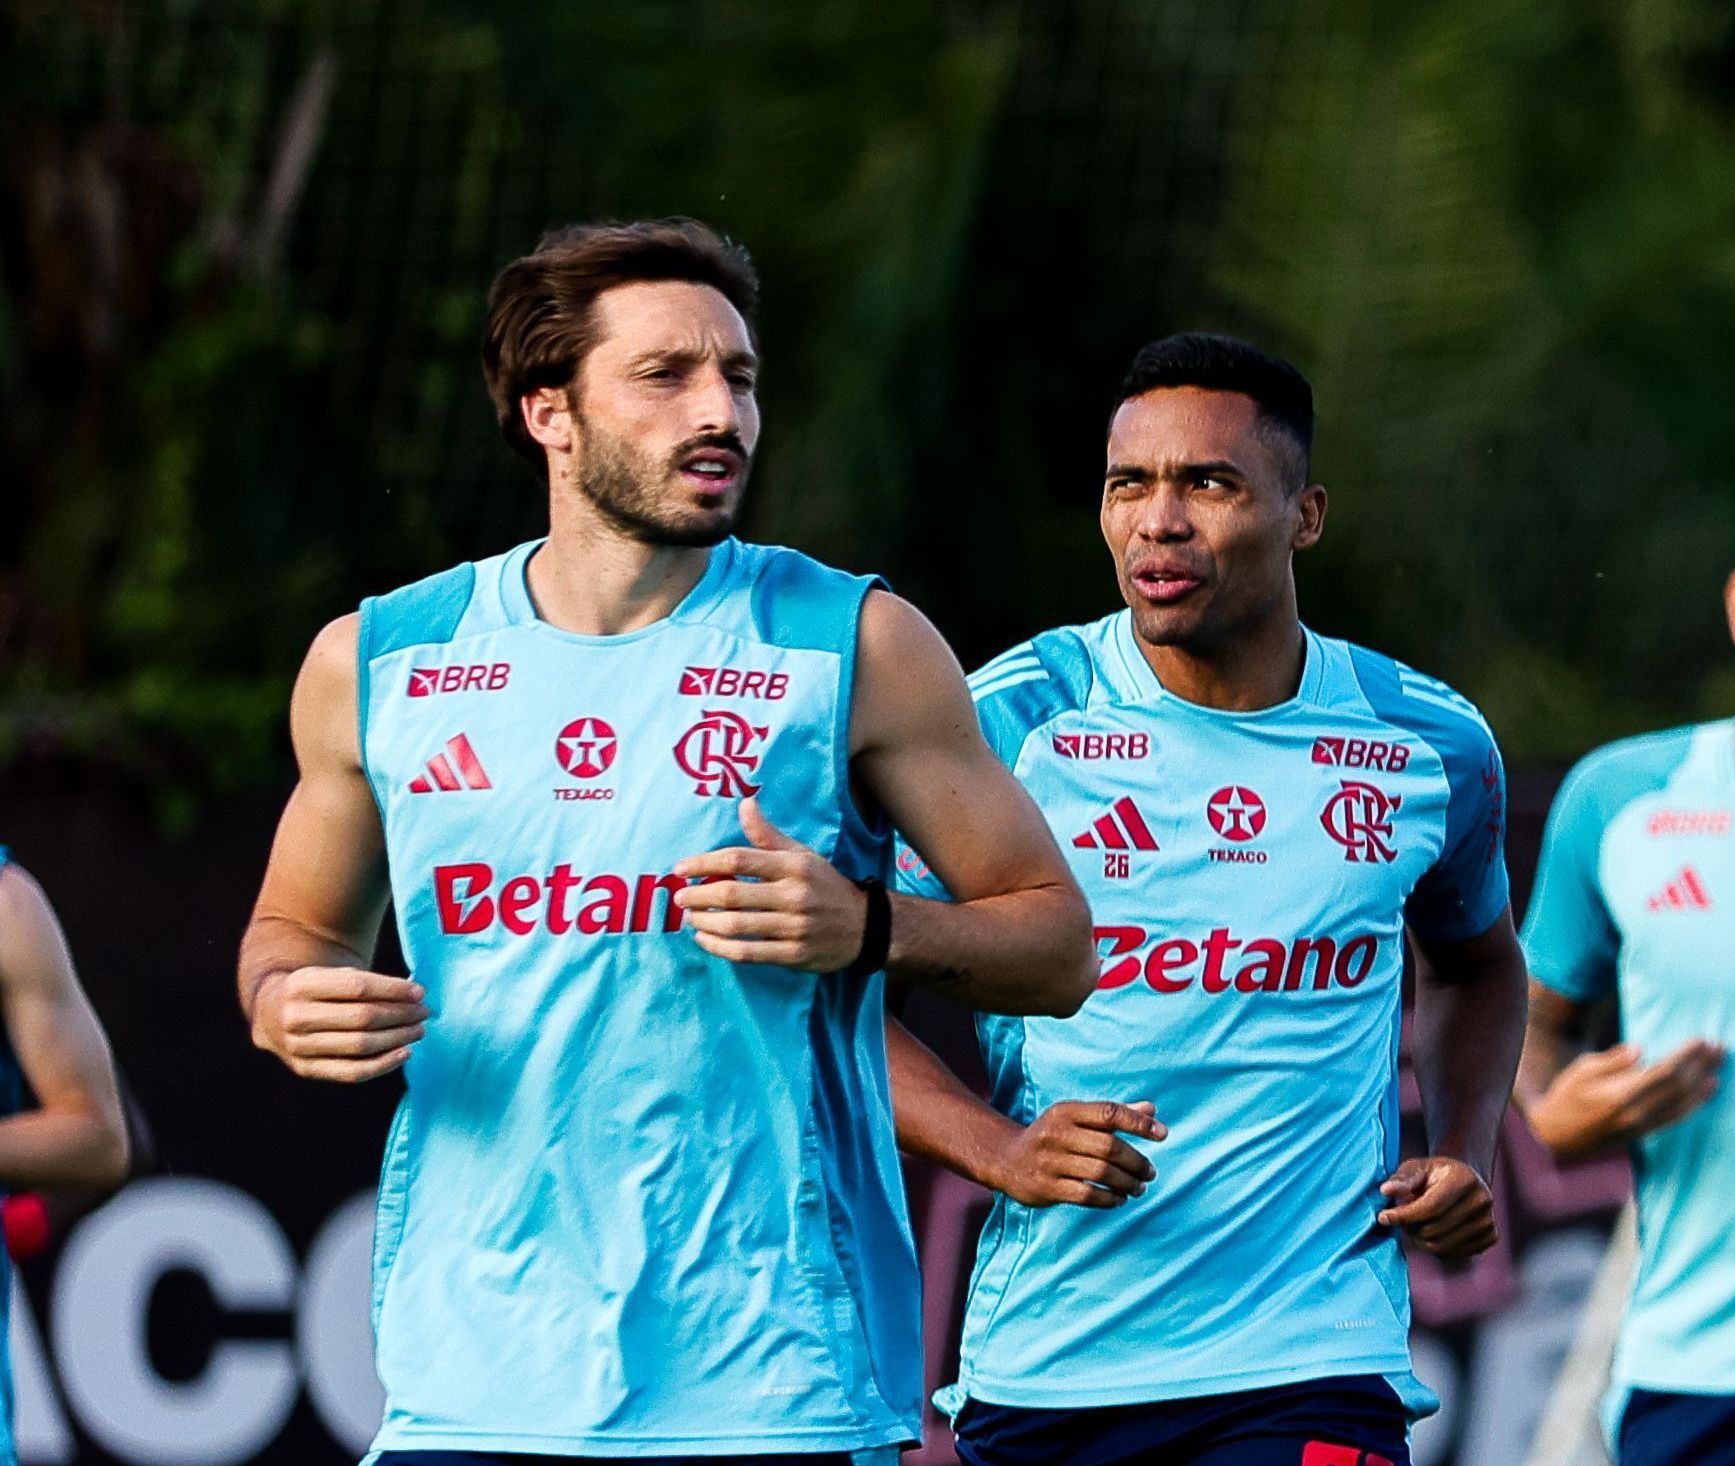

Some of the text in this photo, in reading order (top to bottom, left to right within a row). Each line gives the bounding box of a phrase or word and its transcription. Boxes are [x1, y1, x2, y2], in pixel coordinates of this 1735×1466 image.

[441, 663, 510, 693] BRB
[714, 669, 790, 701] BRB
[1083, 732, 1150, 760] BRB
[1342, 739, 1410, 772] BRB
[553, 788, 613, 801] TEXACO
[1103, 853, 1130, 879] 26
[1207, 848, 1267, 864] TEXACO
[433, 861, 738, 936] Betan
